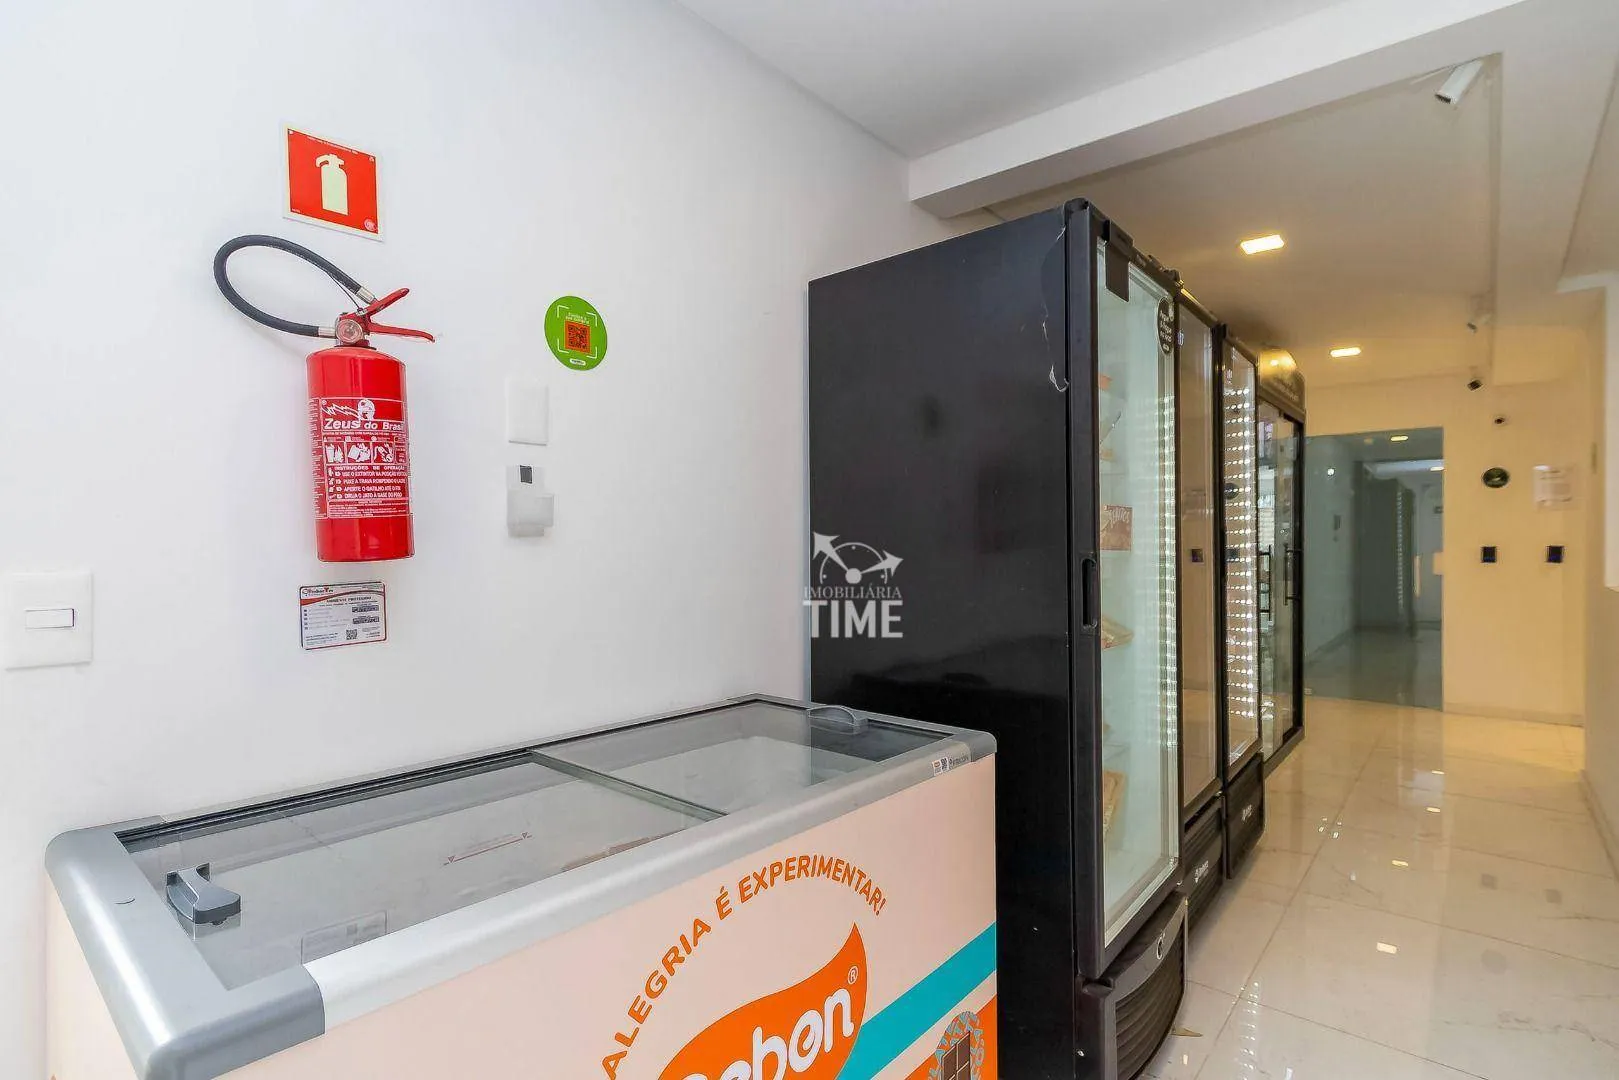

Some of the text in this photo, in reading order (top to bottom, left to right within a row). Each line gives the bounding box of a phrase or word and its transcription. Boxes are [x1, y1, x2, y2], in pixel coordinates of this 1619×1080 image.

[324, 417, 361, 430] Zeus
[363, 421, 378, 430] do
[601, 855, 887, 1080] ALEGRIA É EXPERIMENTAR!
